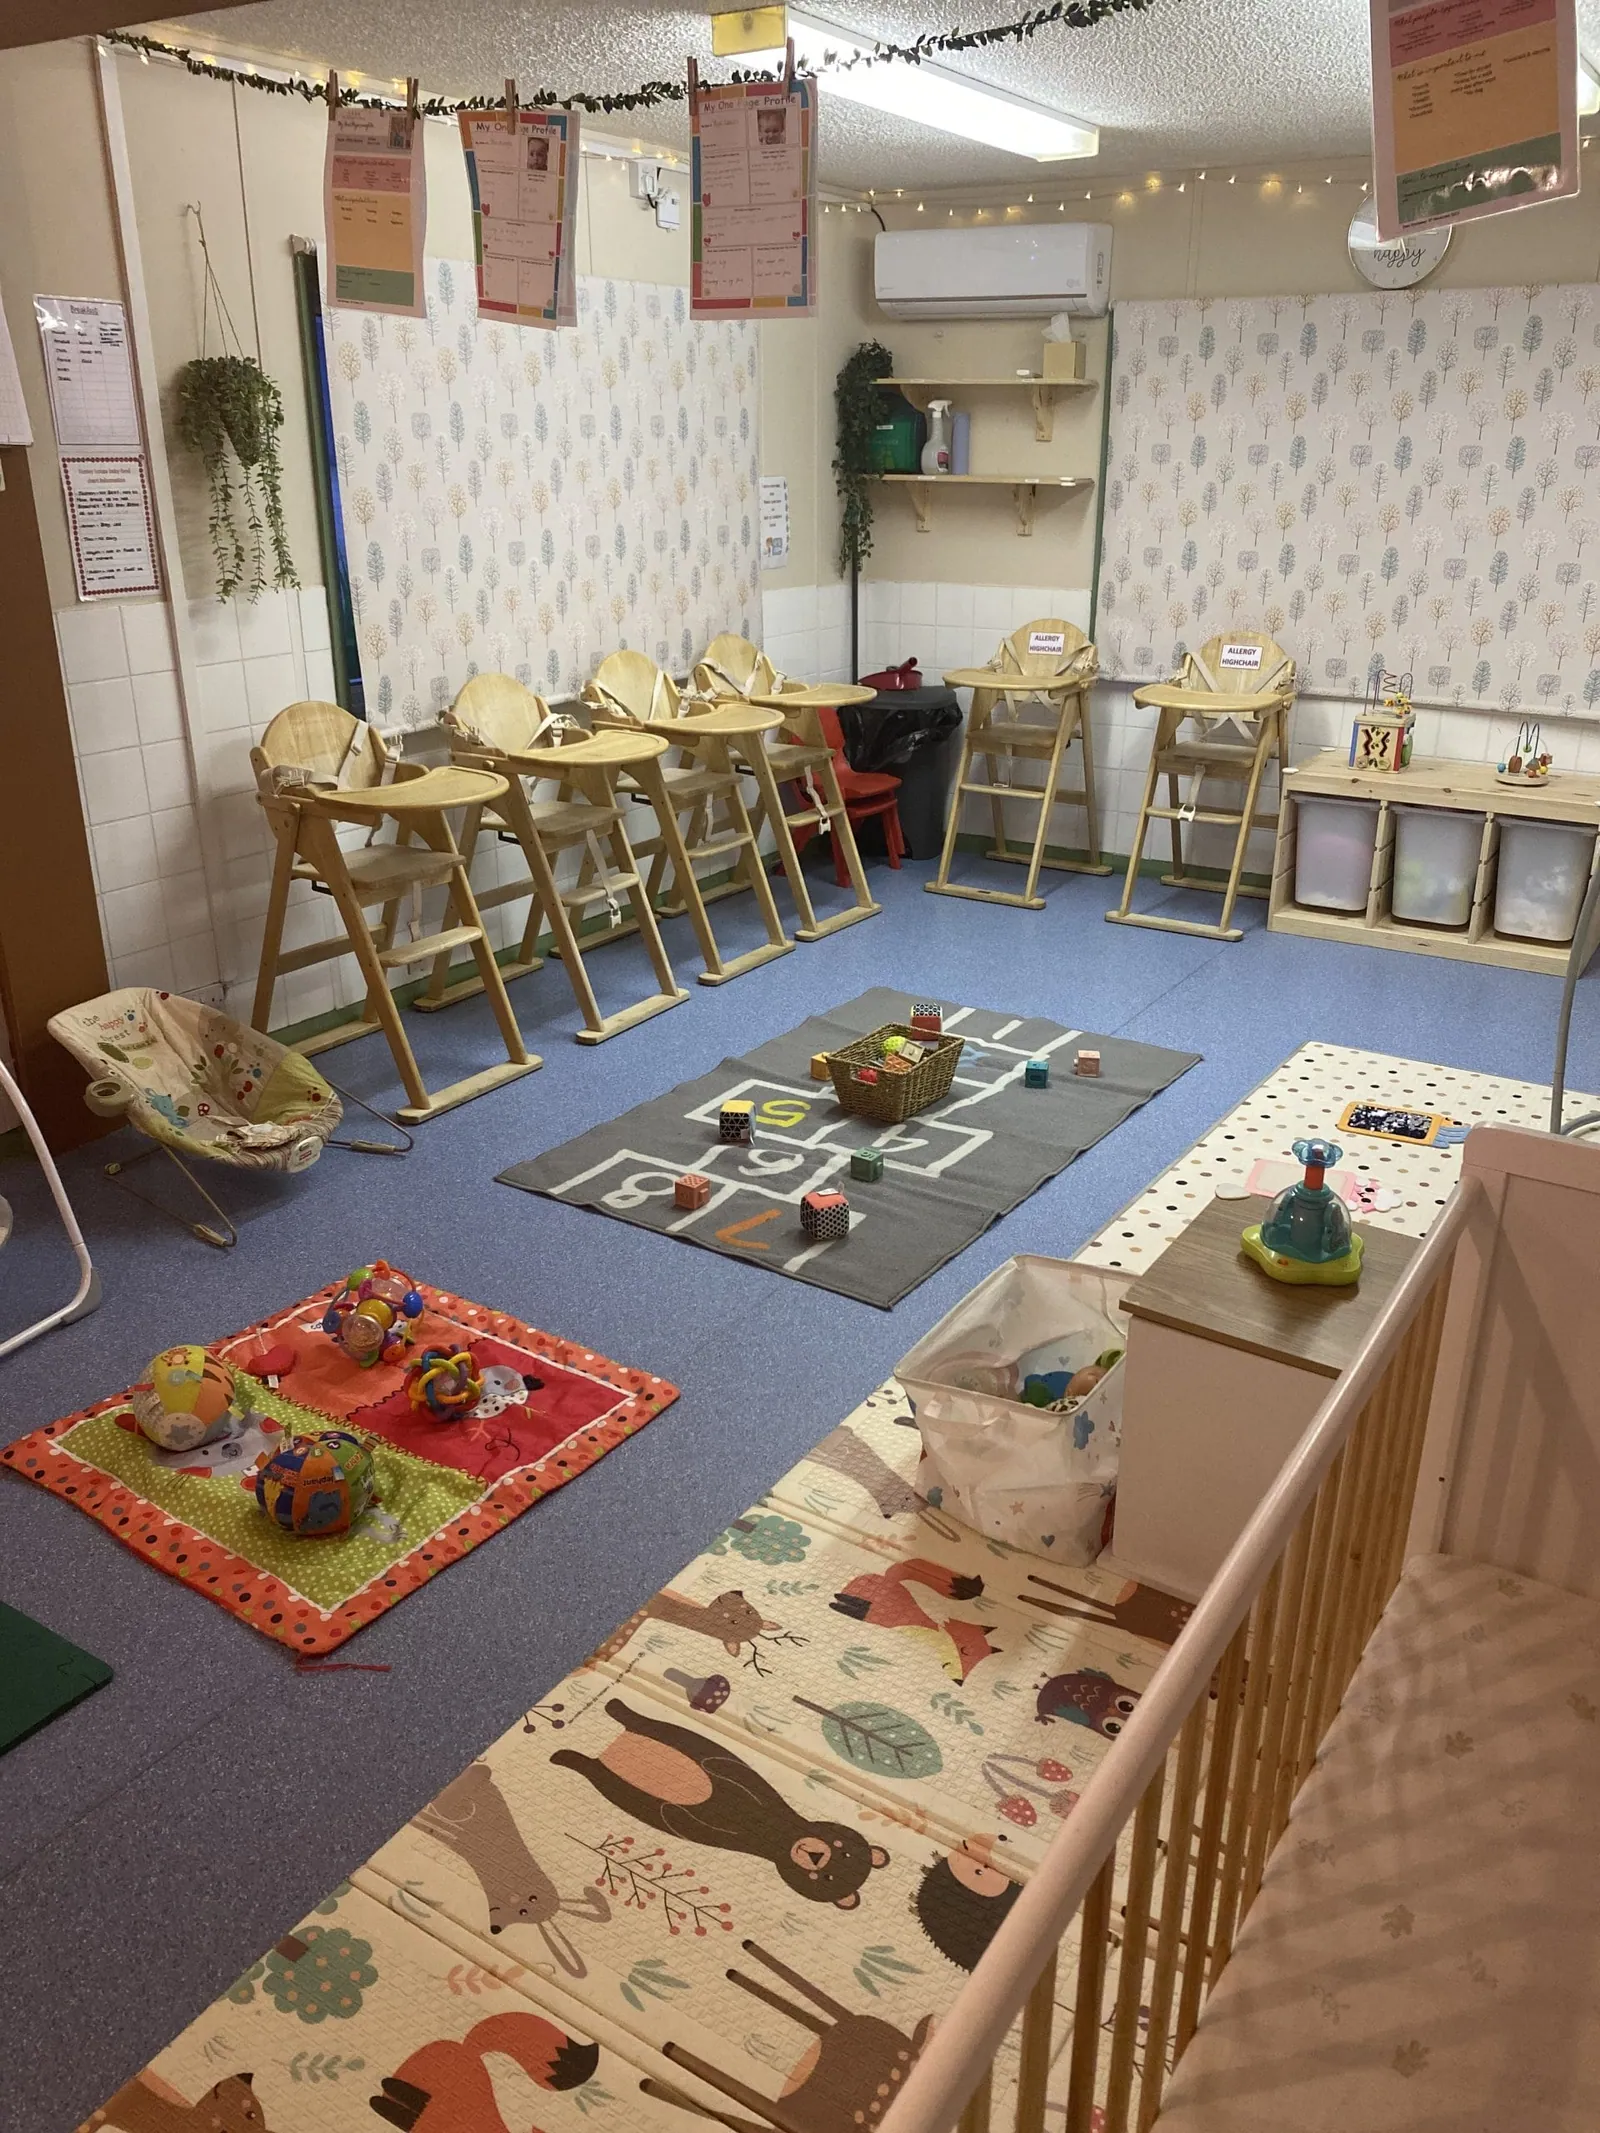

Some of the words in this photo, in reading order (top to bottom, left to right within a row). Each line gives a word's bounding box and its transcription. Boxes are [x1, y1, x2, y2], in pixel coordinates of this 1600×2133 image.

[704, 102, 716, 114] My
[718, 101, 734, 111] One
[764, 96, 797, 106] Profile
[476, 121, 491, 133] My
[531, 124, 557, 136] Profile
[1035, 634, 1061, 642] ALLERGY
[1029, 645, 1062, 653] HIGHCHAIR
[1228, 647, 1257, 656] ALLERGY
[1222, 658, 1259, 668] HIGHCHAIR
[83, 1015, 99, 1026] the
